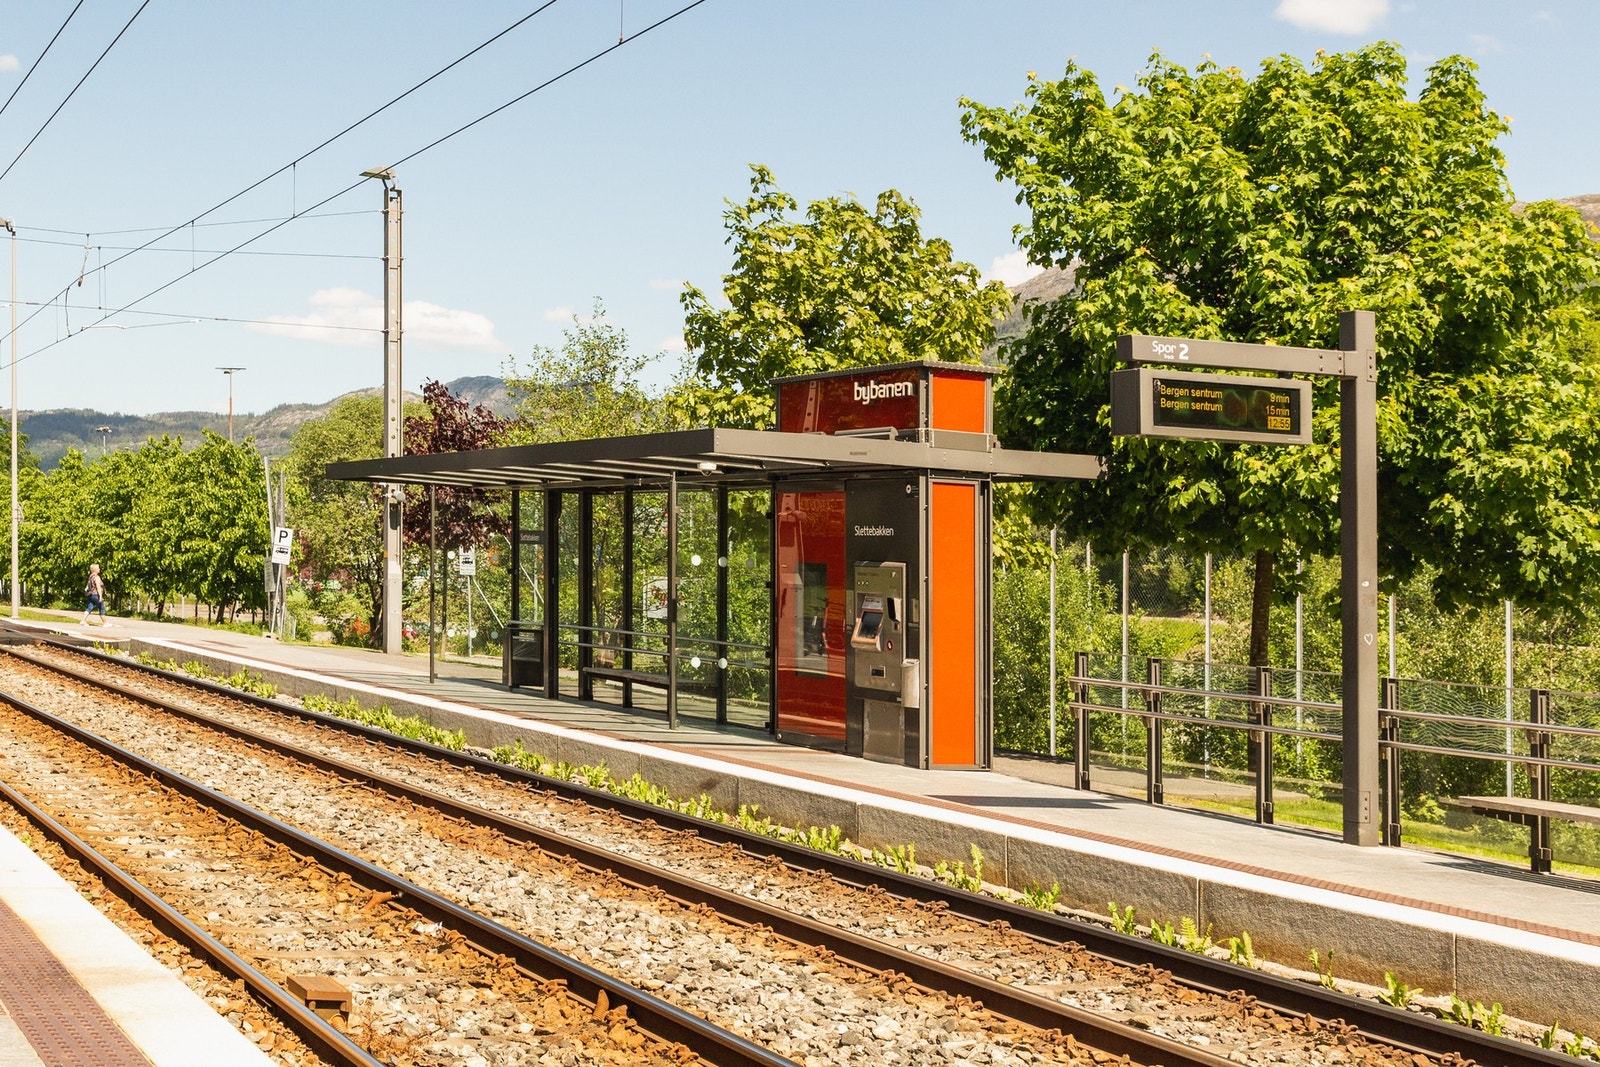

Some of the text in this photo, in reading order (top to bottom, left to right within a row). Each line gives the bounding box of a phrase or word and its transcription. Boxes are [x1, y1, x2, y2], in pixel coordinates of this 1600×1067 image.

[1152, 340, 1189, 360] Spor 2
[854, 379, 914, 405] bybanen
[1160, 384, 1223, 399] Bergen sentrum
[1160, 397, 1223, 412] Bergen sentrum
[278, 529, 289, 543] P
[854, 525, 895, 537] Slettebakken
